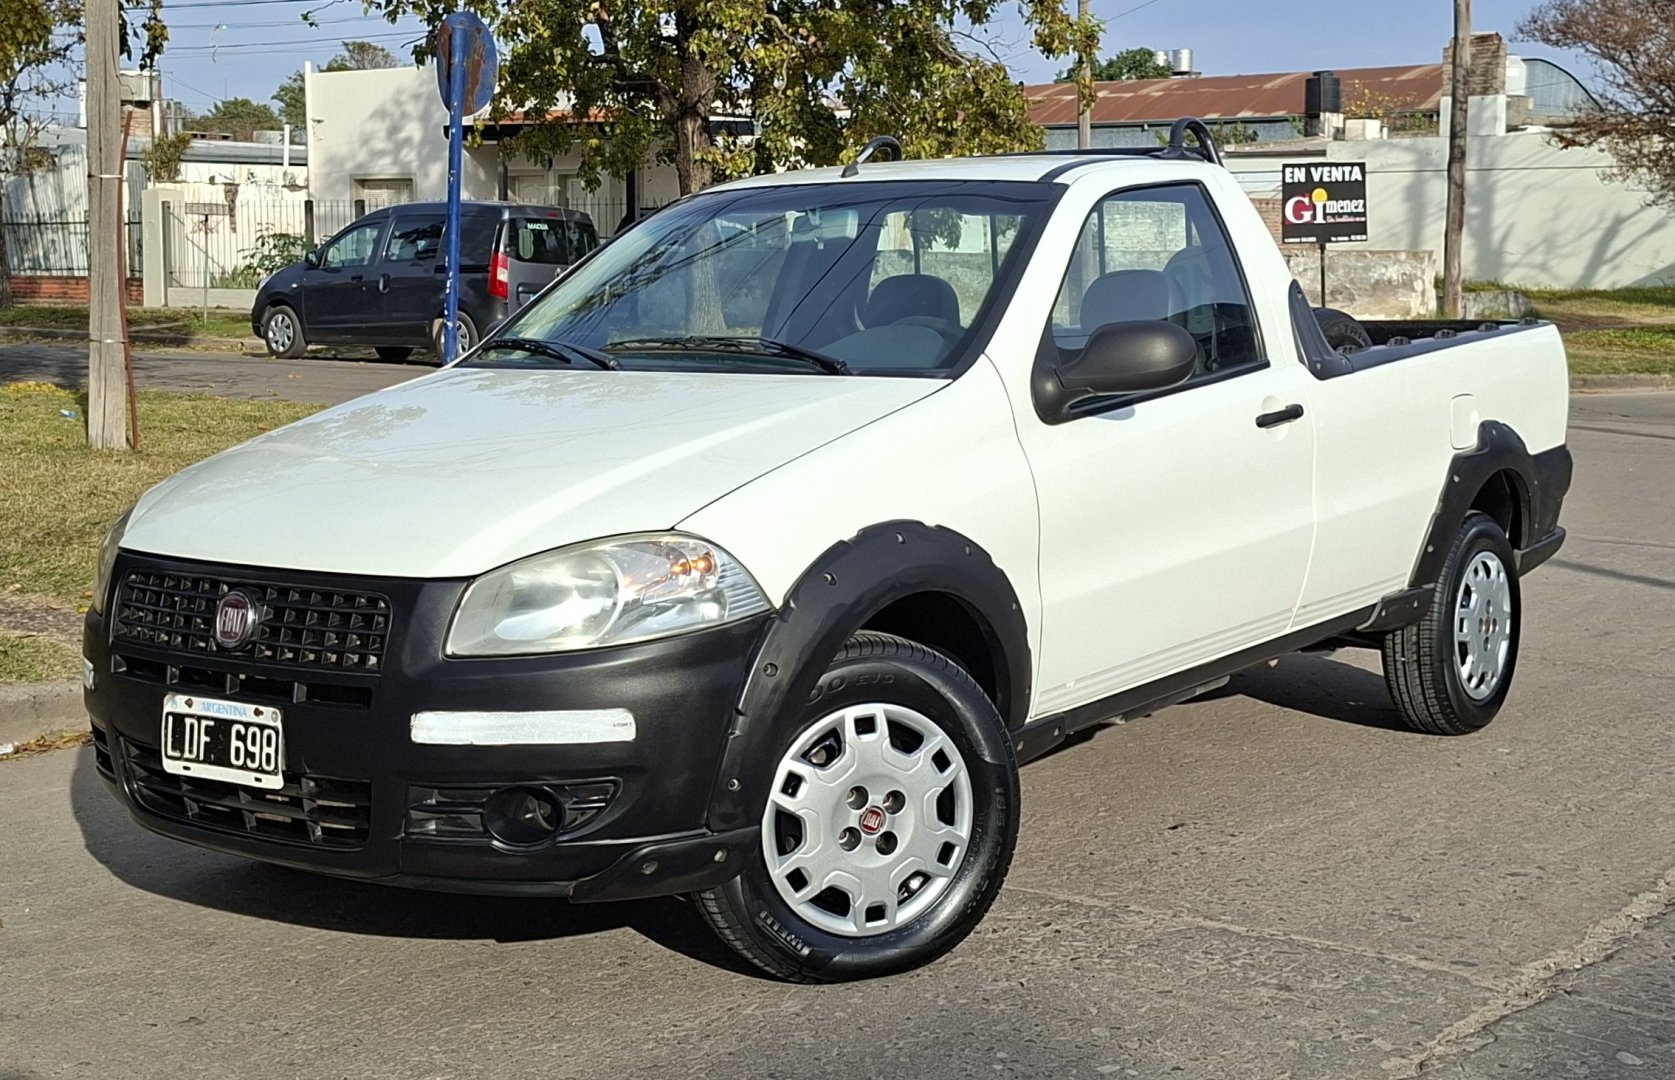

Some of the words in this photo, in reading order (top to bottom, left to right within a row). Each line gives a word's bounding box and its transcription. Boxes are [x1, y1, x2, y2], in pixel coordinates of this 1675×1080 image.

[1285, 167, 1306, 183] EN
[1310, 165, 1363, 182] VENTA
[220, 606, 246, 633] FIAT
[201, 702, 248, 717] ARGENTINA
[166, 714, 215, 761] LDF
[230, 723, 277, 772] 698
